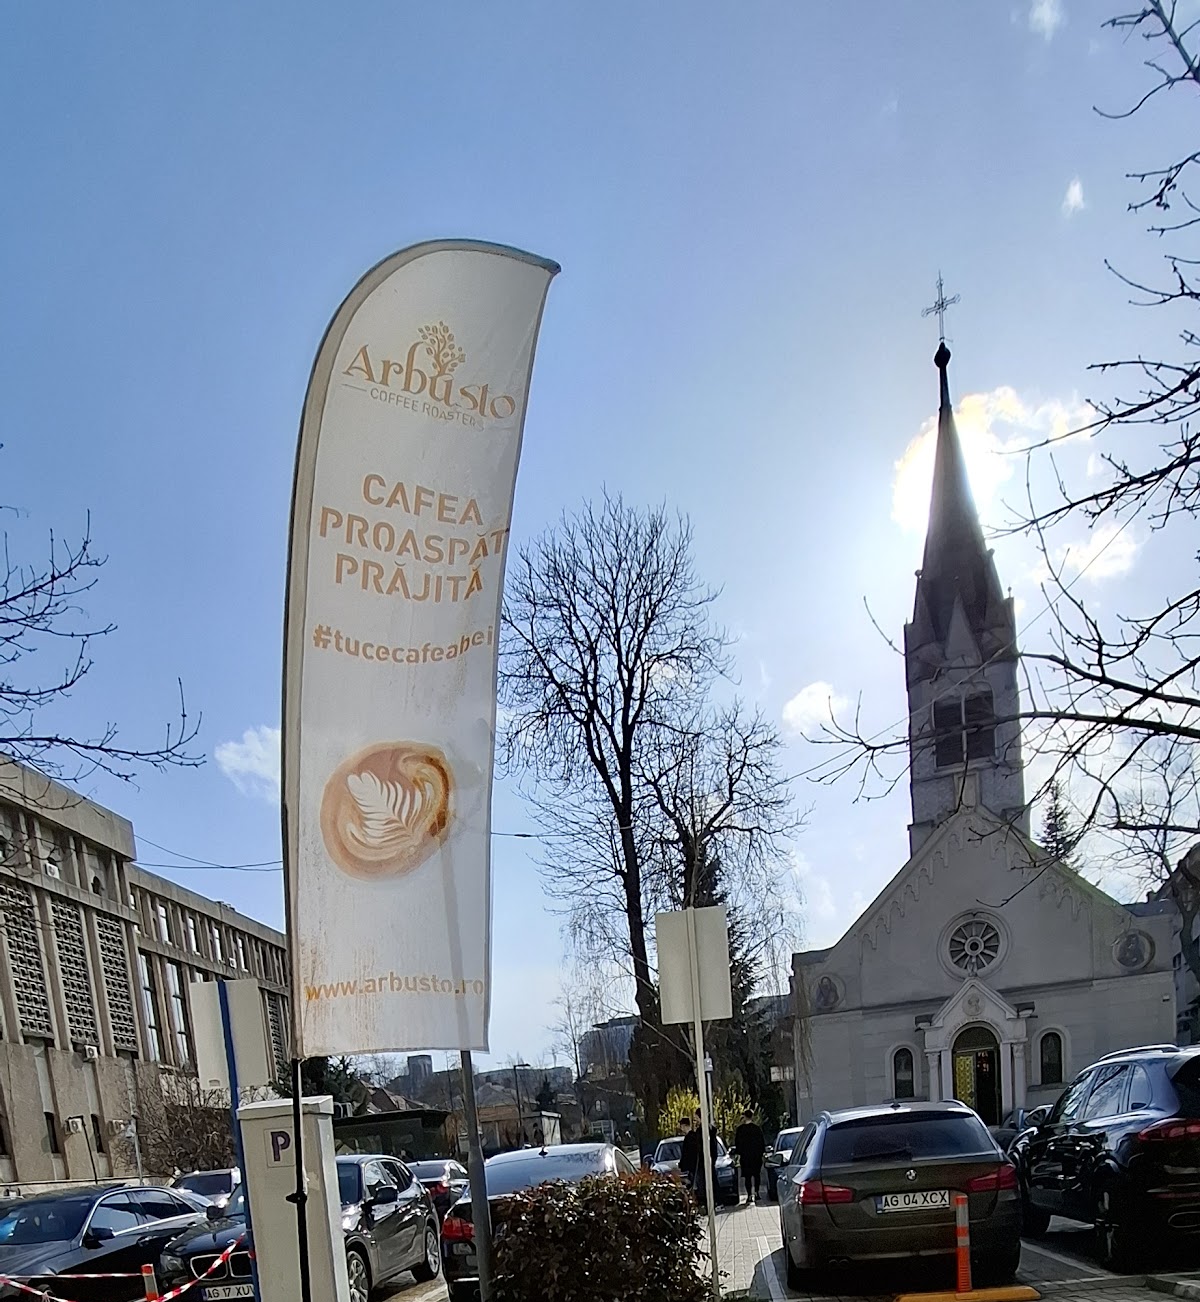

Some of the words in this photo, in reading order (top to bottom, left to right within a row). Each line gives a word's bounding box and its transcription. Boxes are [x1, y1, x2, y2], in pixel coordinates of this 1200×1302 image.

[341, 341, 516, 420] Arbusto
[370, 387, 419, 413] COFFEE
[363, 473, 484, 527] CAFEA
[319, 505, 507, 566] PROASPĂT
[335, 553, 484, 603] PRĂJITĂ
[304, 972, 485, 1001] www.arbusto.ro
[271, 1130, 291, 1163] P
[884, 1196, 899, 1207] AG
[903, 1194, 918, 1205] 04
[921, 1191, 947, 1204] XCX
[207, 1288, 220, 1299] AG
[222, 1287, 231, 1298] 17
